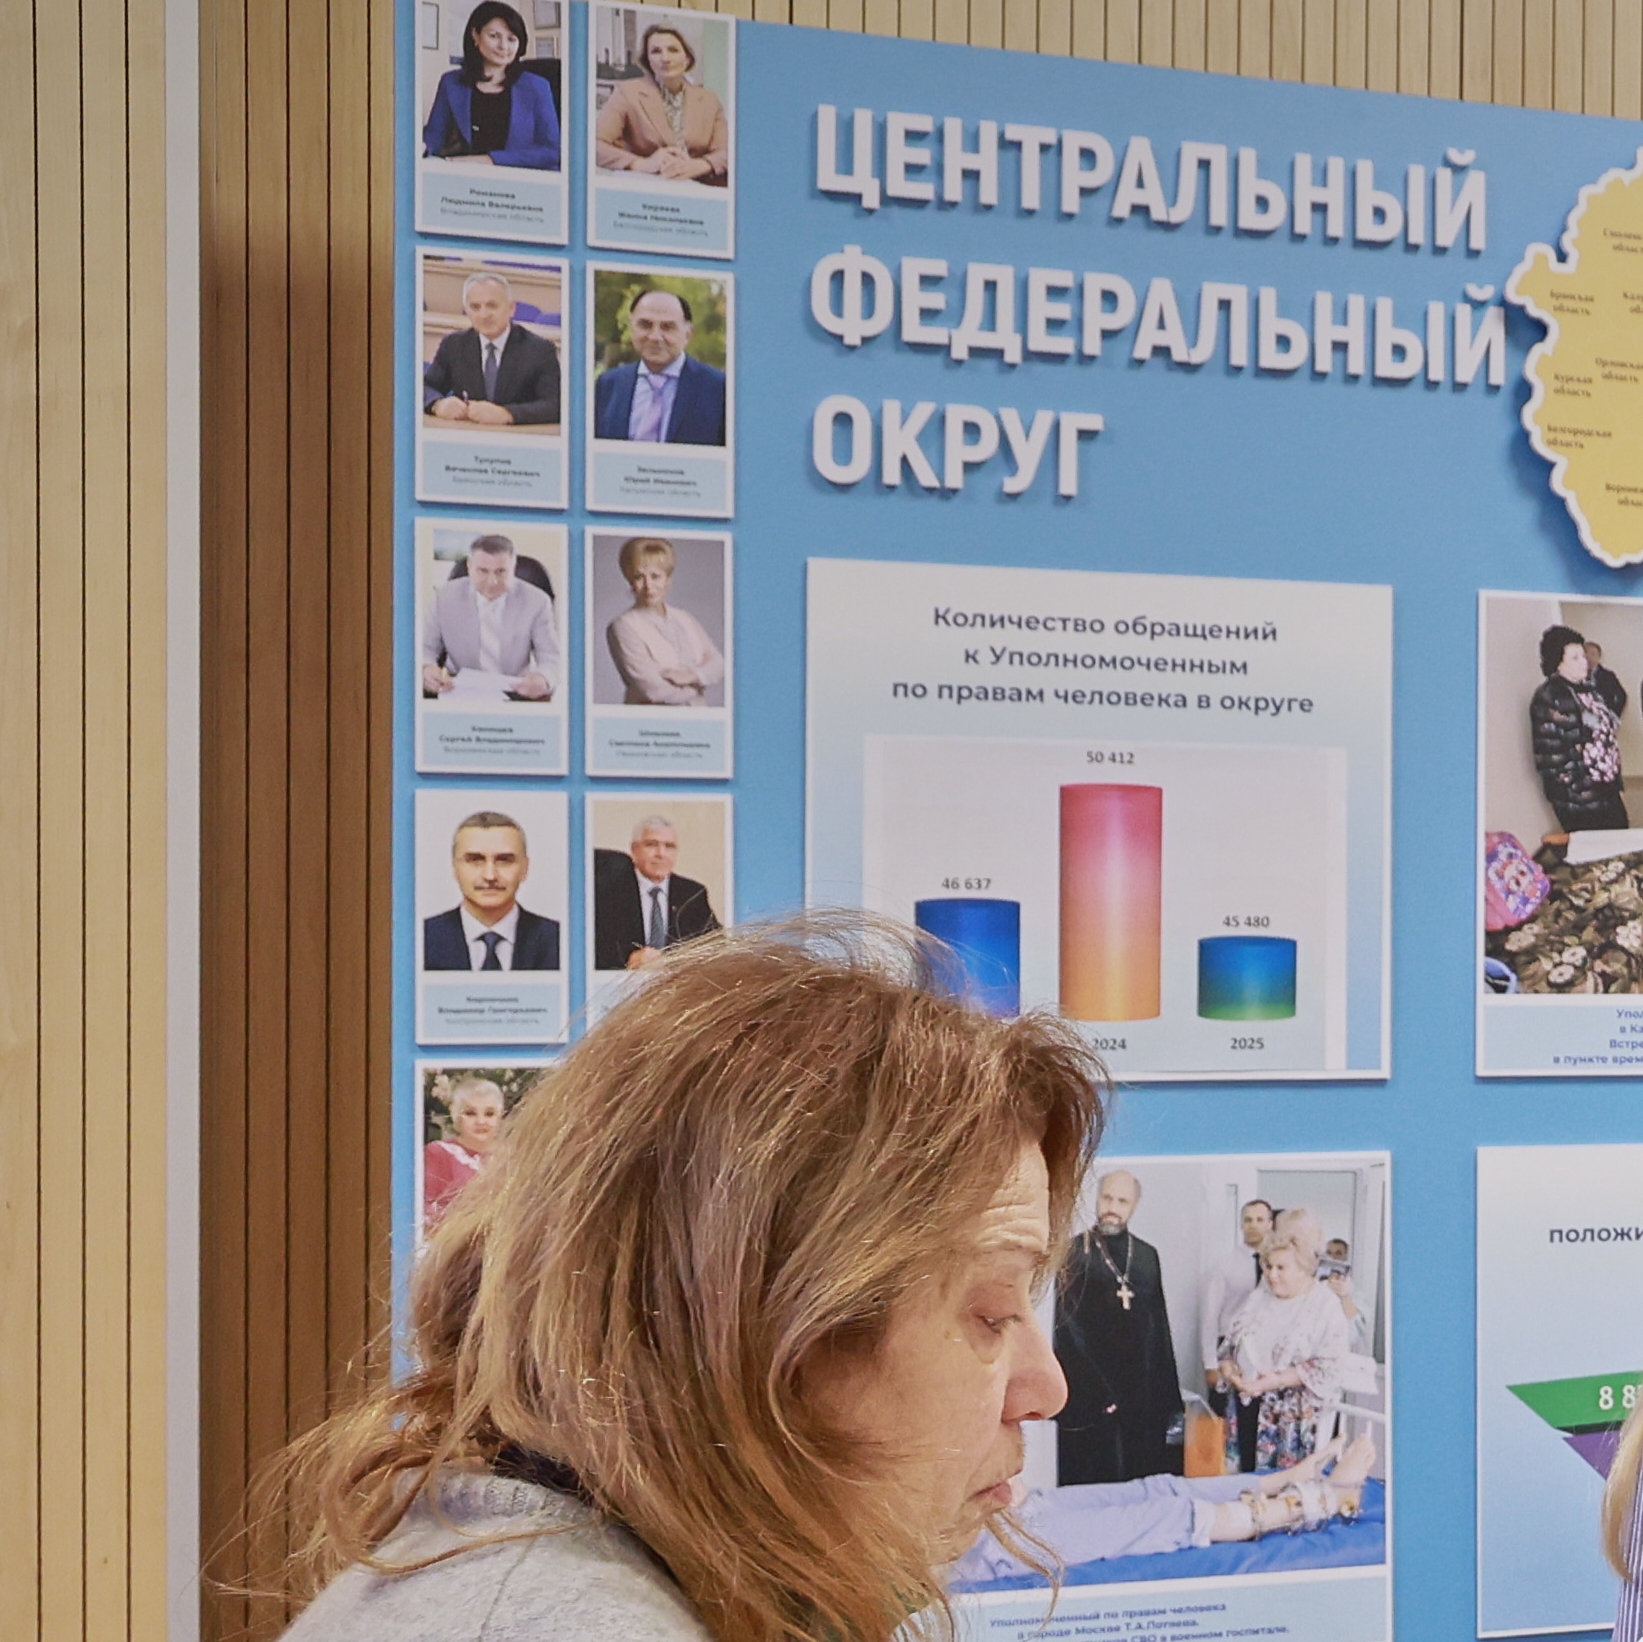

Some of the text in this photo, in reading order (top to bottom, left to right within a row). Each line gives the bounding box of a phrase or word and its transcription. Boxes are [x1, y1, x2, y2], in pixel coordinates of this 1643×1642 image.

[816, 104, 1488, 252] ЦЕНТРАЛЬНЫЙ
[810, 245, 1506, 387] ФЕДЕРАЛЬНЫЙ
[812, 395, 1104, 498] ОКРУГ
[933, 607, 1278, 644] Количество обращений
[964, 646, 1248, 676] к Уполномоченным
[892, 681, 1314, 717] по правам человека в округе
[1086, 751, 1135, 765] 50 412
[941, 877, 992, 891] 46 637
[1222, 915, 1270, 929] 45 480
[1230, 1037, 1265, 1051] 2025
[1563, 1055, 1608, 1066] пункте
